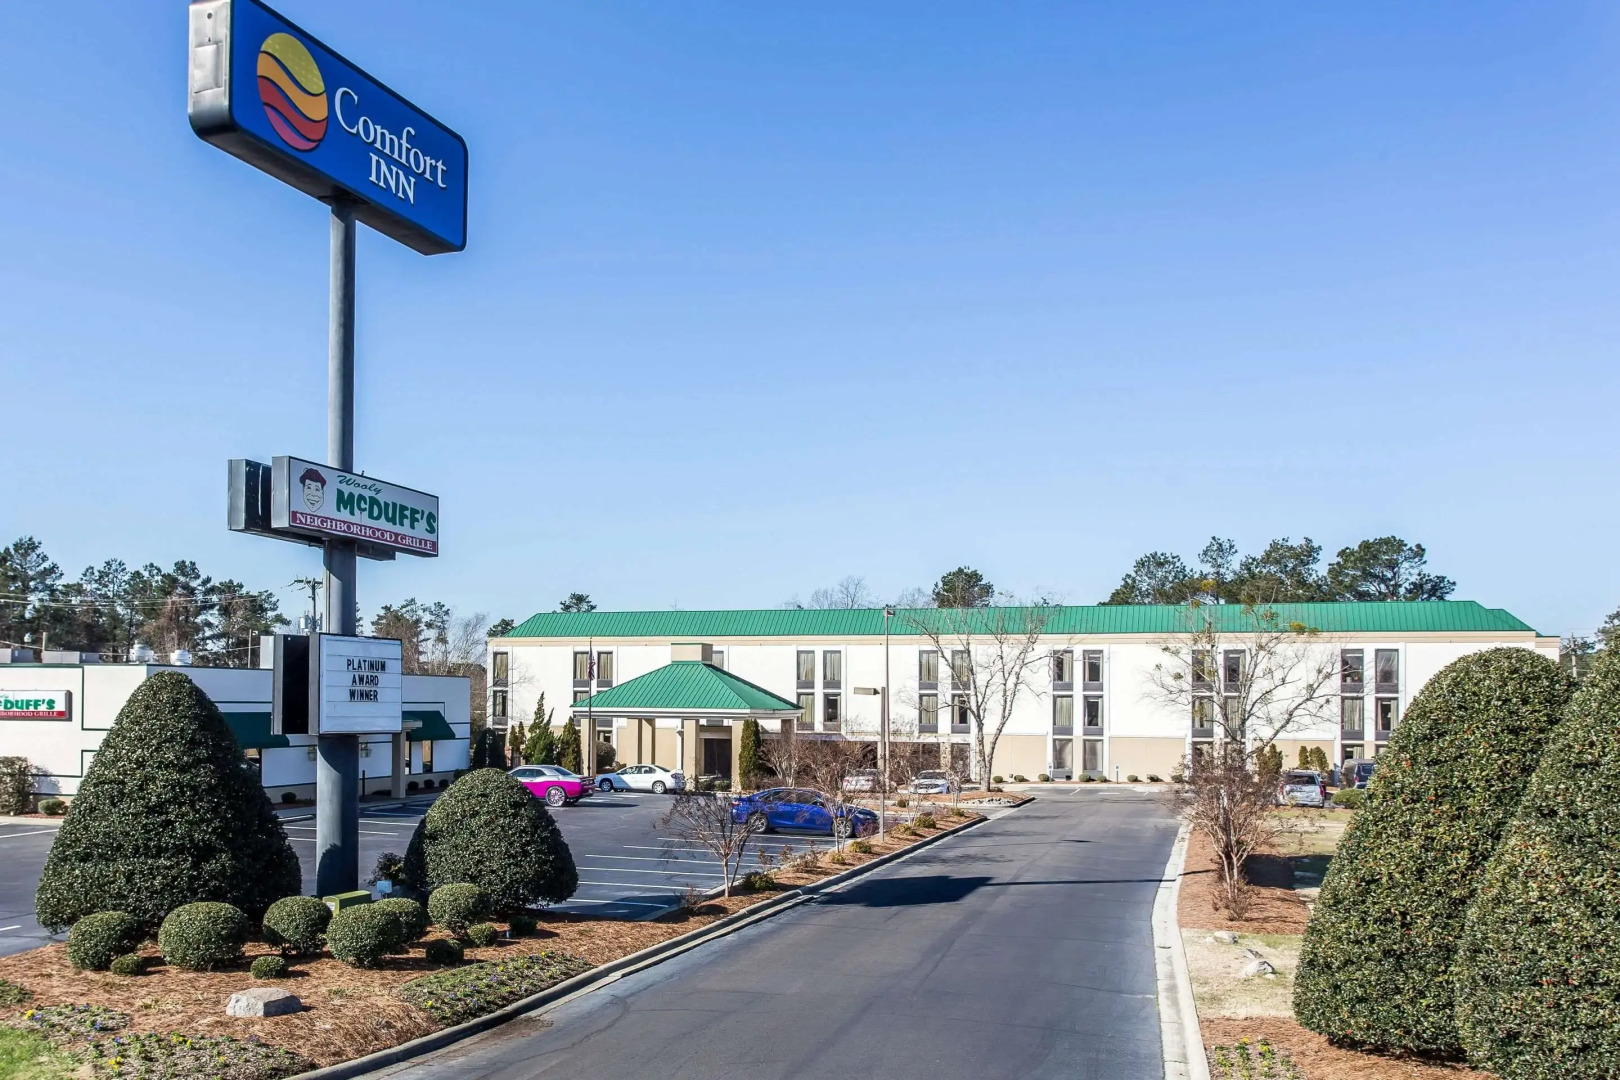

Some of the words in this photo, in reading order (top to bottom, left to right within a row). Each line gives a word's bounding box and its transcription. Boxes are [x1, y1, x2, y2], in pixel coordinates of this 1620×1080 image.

[335, 88, 447, 188] Comfort
[369, 153, 415, 204] INN
[337, 475, 383, 495] Wooly
[296, 513, 395, 542] NEIGHBORHOOD
[398, 534, 433, 550] GRILLE
[346, 659, 386, 671] PLATINUM
[352, 674, 379, 686] AWARD
[349, 688, 379, 702] WINNER
[0, 699, 56, 710] DUFF'S
